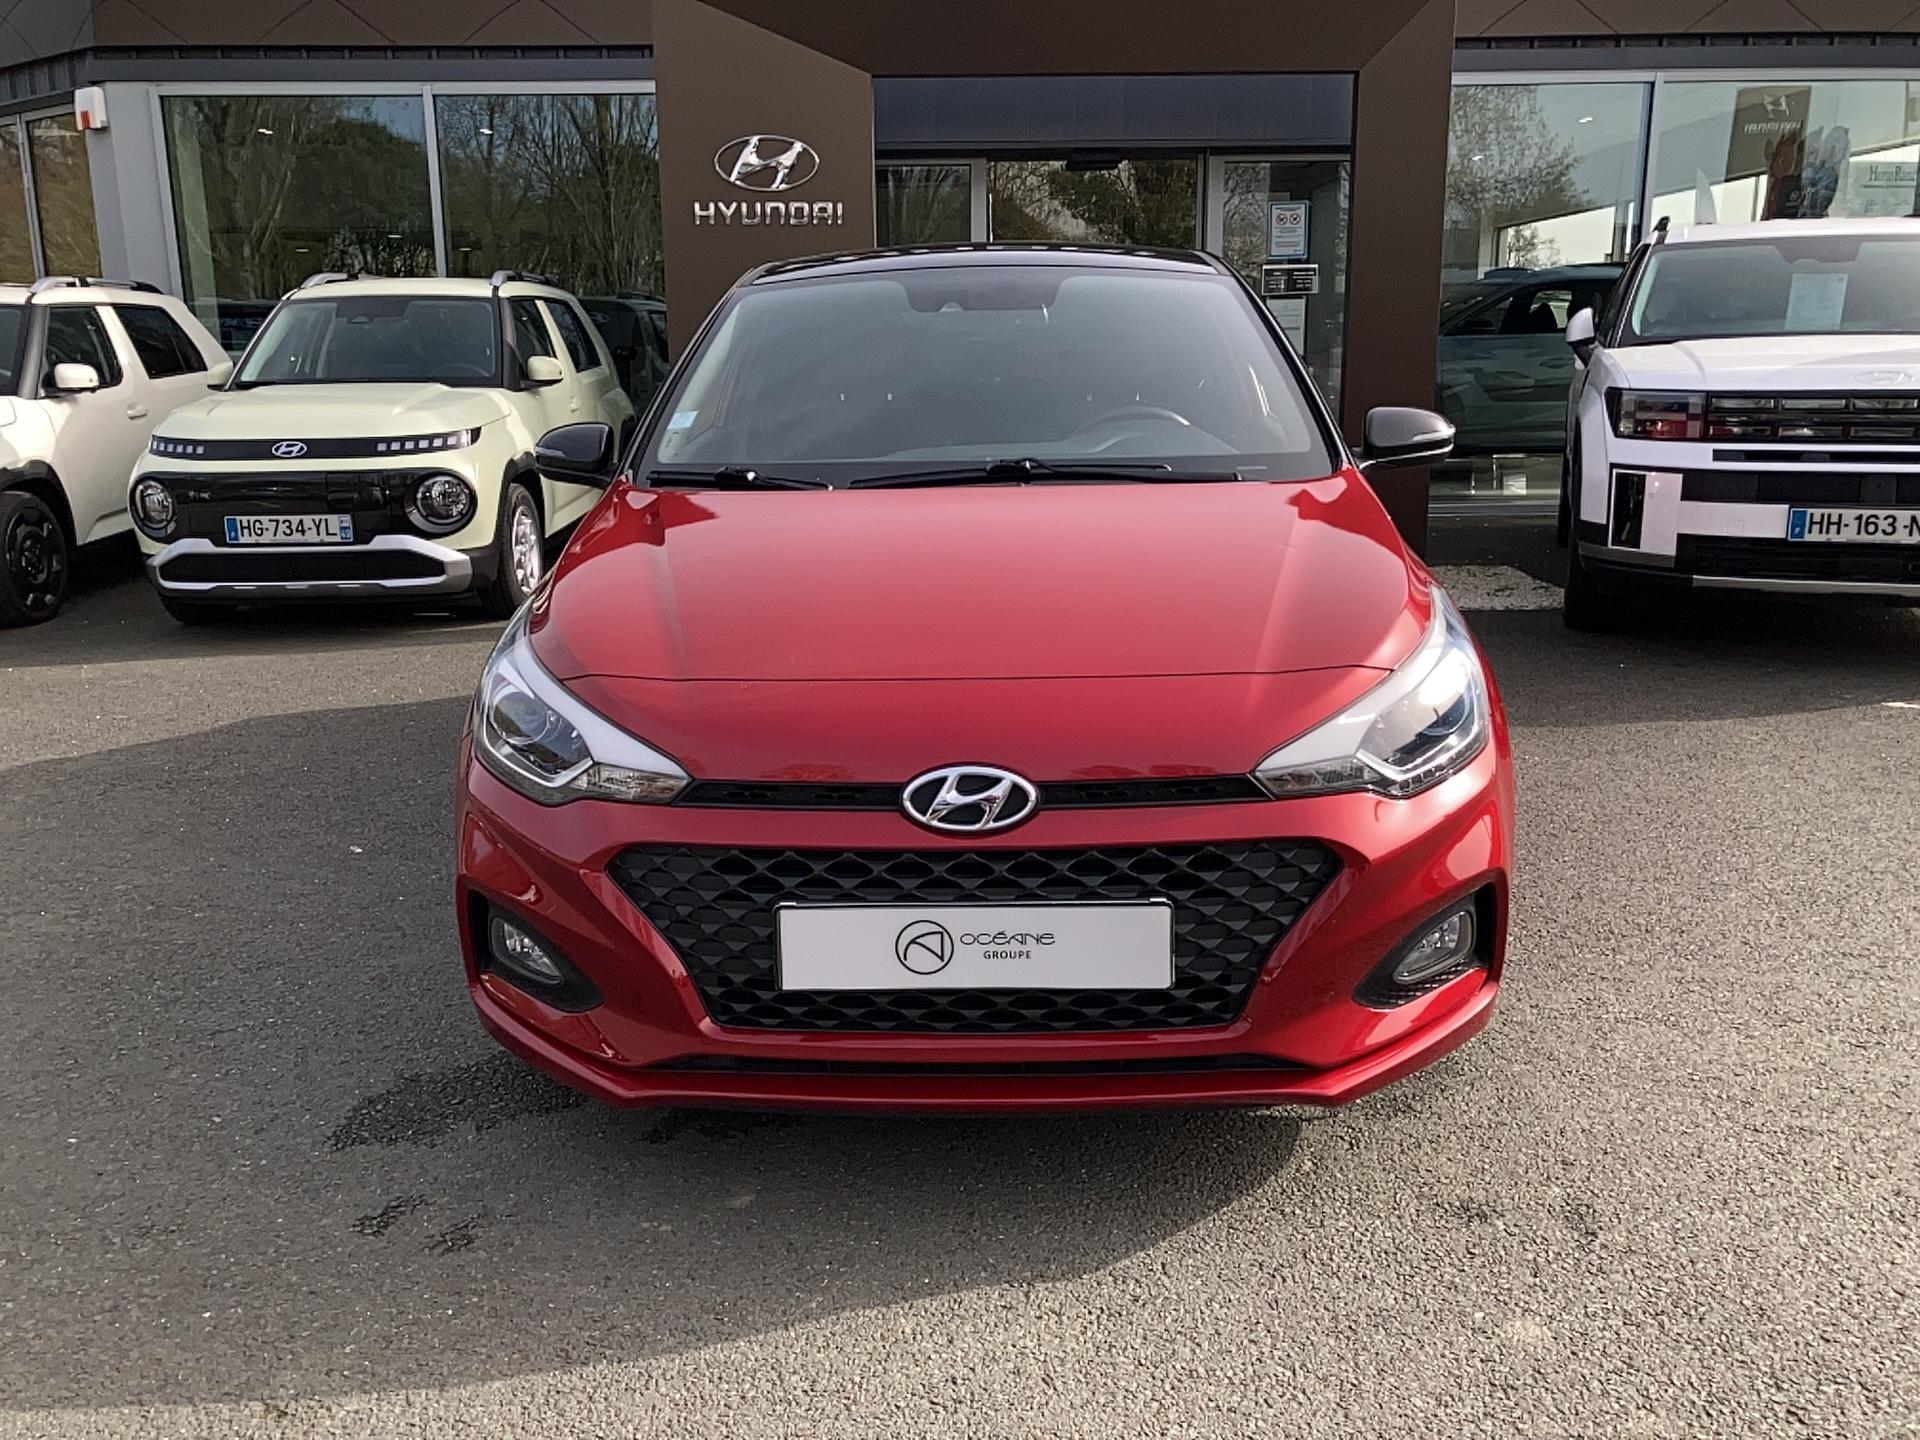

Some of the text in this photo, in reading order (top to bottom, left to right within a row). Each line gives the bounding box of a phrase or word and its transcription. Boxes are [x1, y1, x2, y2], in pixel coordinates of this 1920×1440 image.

[694, 201, 843, 226] HYUNDAI
[239, 518, 338, 538] HG-734-YL
[983, 950, 1032, 960] GROUPE
